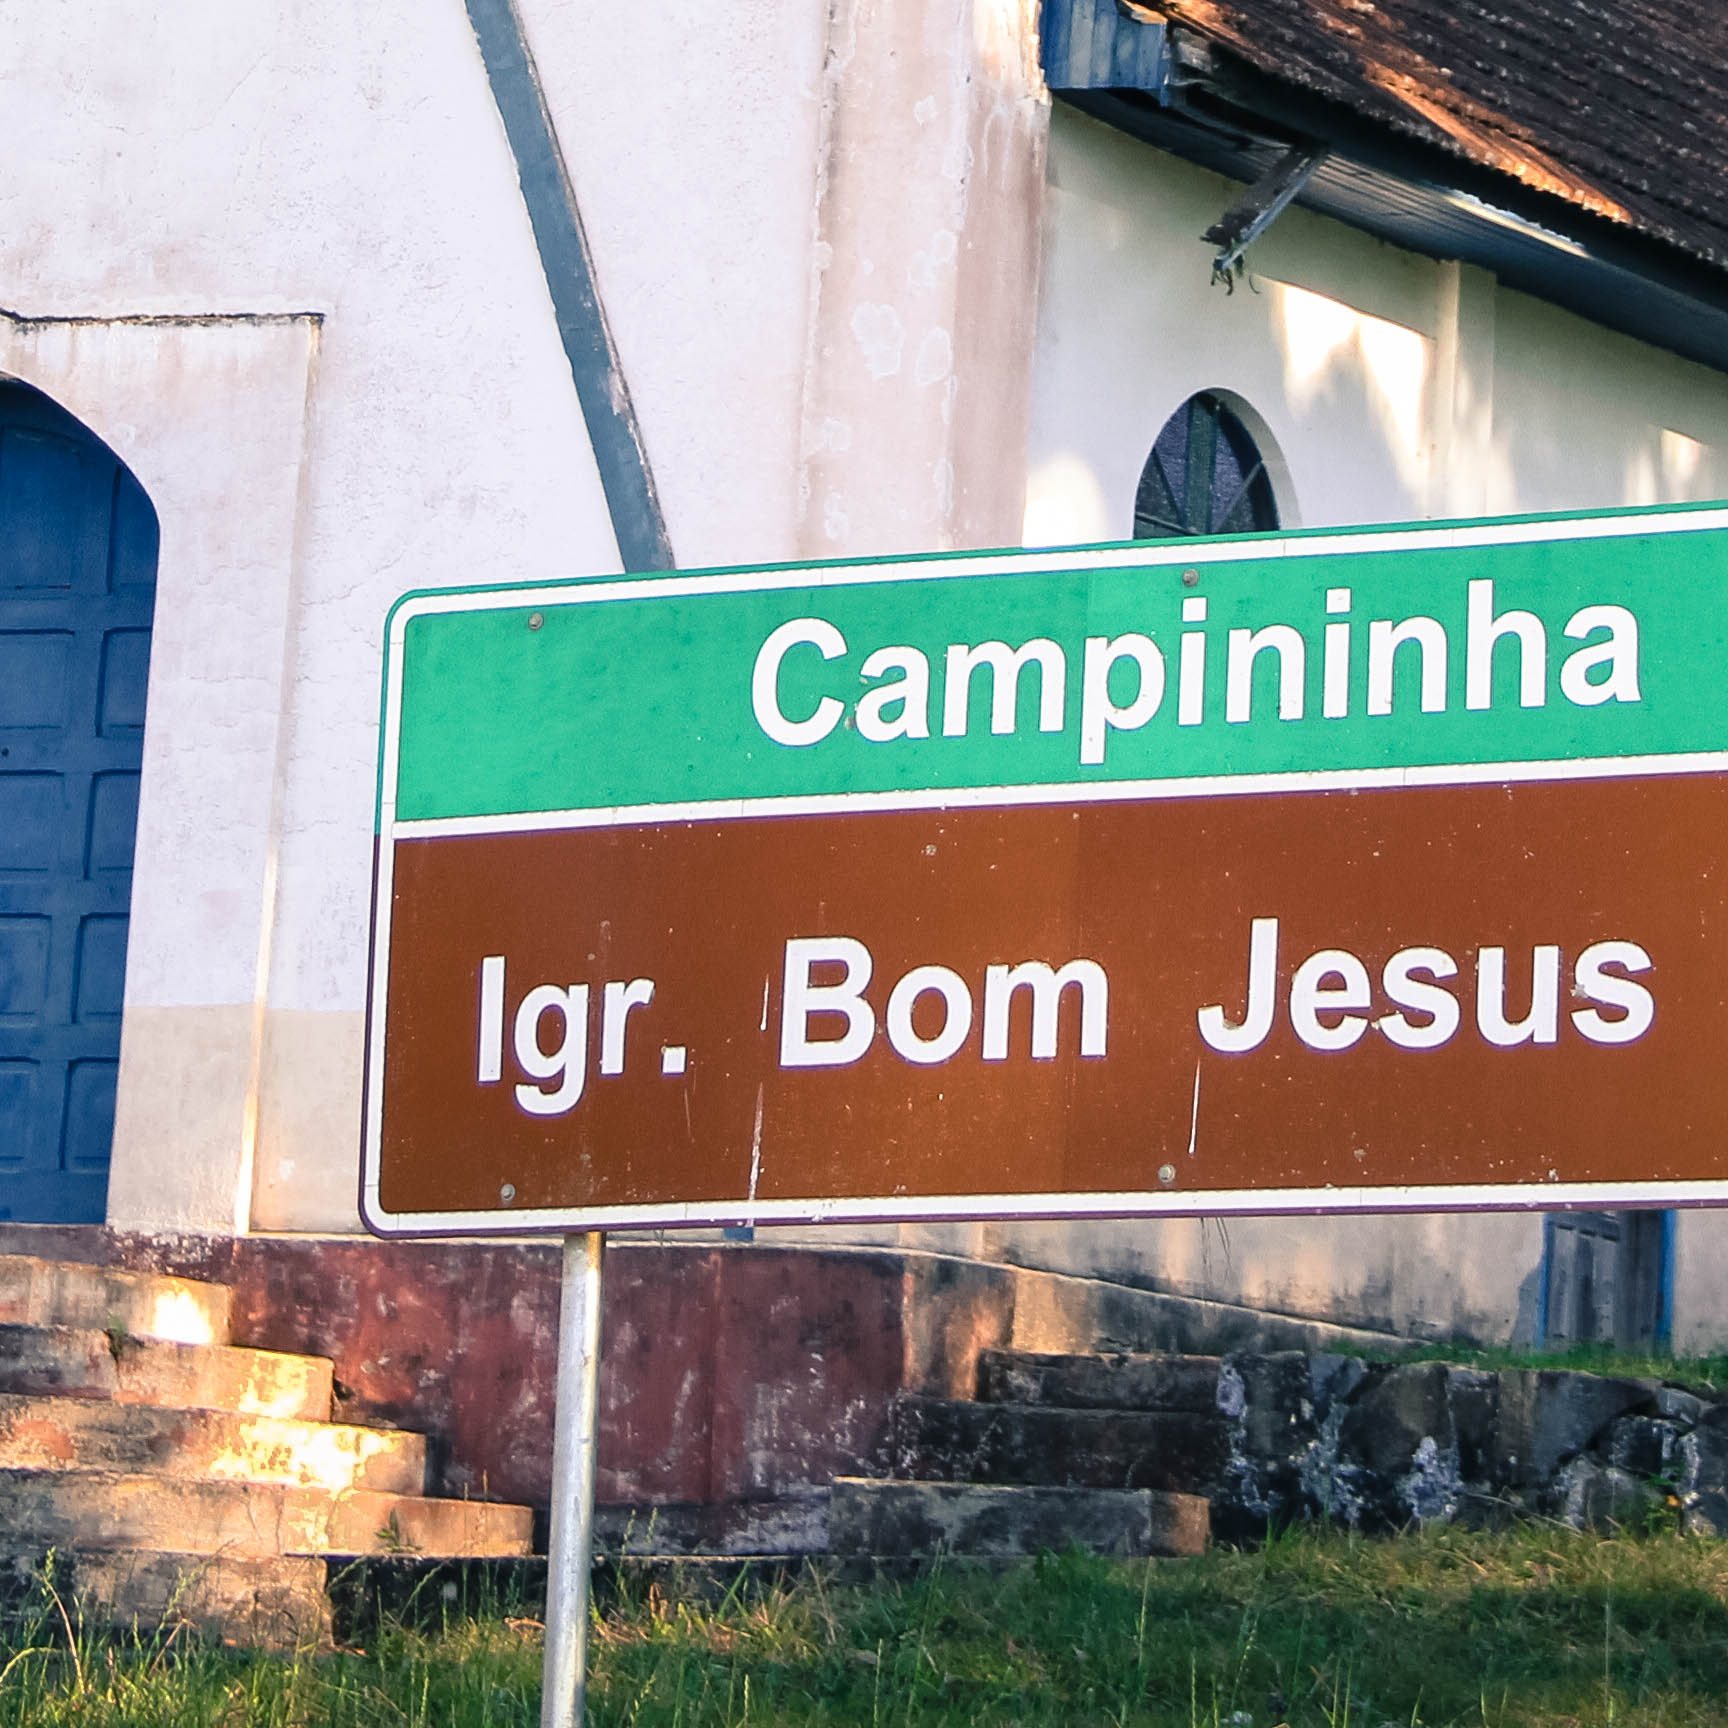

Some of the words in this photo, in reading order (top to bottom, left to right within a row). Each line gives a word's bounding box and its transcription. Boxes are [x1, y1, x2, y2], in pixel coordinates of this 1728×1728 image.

[750, 578, 1643, 765] Campininha
[477, 956, 686, 1115] Igr.
[779, 937, 1108, 1067] Bom
[1198, 917, 1655, 1052] Jesus
